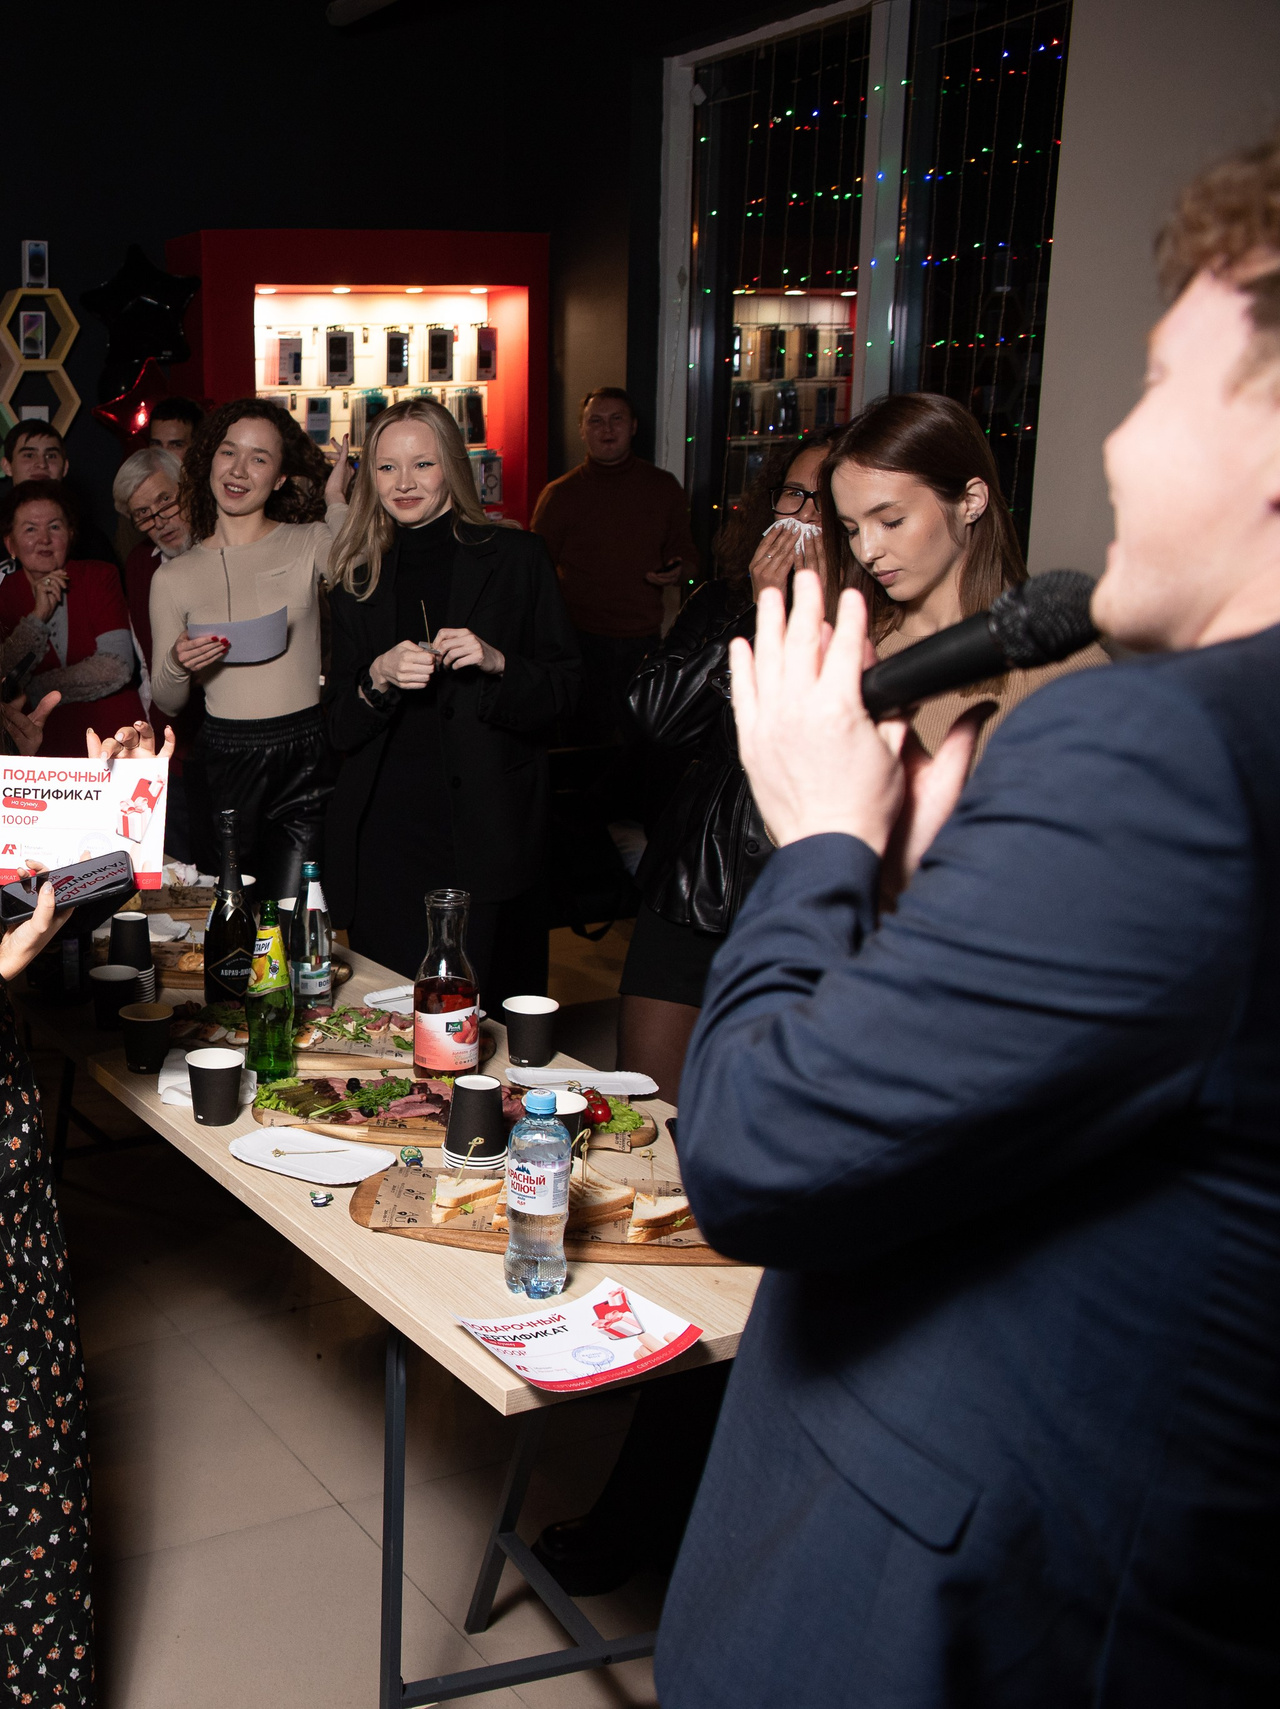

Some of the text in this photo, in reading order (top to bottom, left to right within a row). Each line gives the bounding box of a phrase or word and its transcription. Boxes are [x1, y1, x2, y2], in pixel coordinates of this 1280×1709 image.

[3, 768, 111, 783] ПОДАРОЧНЫЙ
[2, 787, 102, 801] СЕРТИФИКАТ
[511, 1180, 536, 1195] КЛЮЧ
[461, 1313, 567, 1333] ПОДАРОЧНЫЙ
[474, 1325, 569, 1342] СЕРТИФИКАТ
